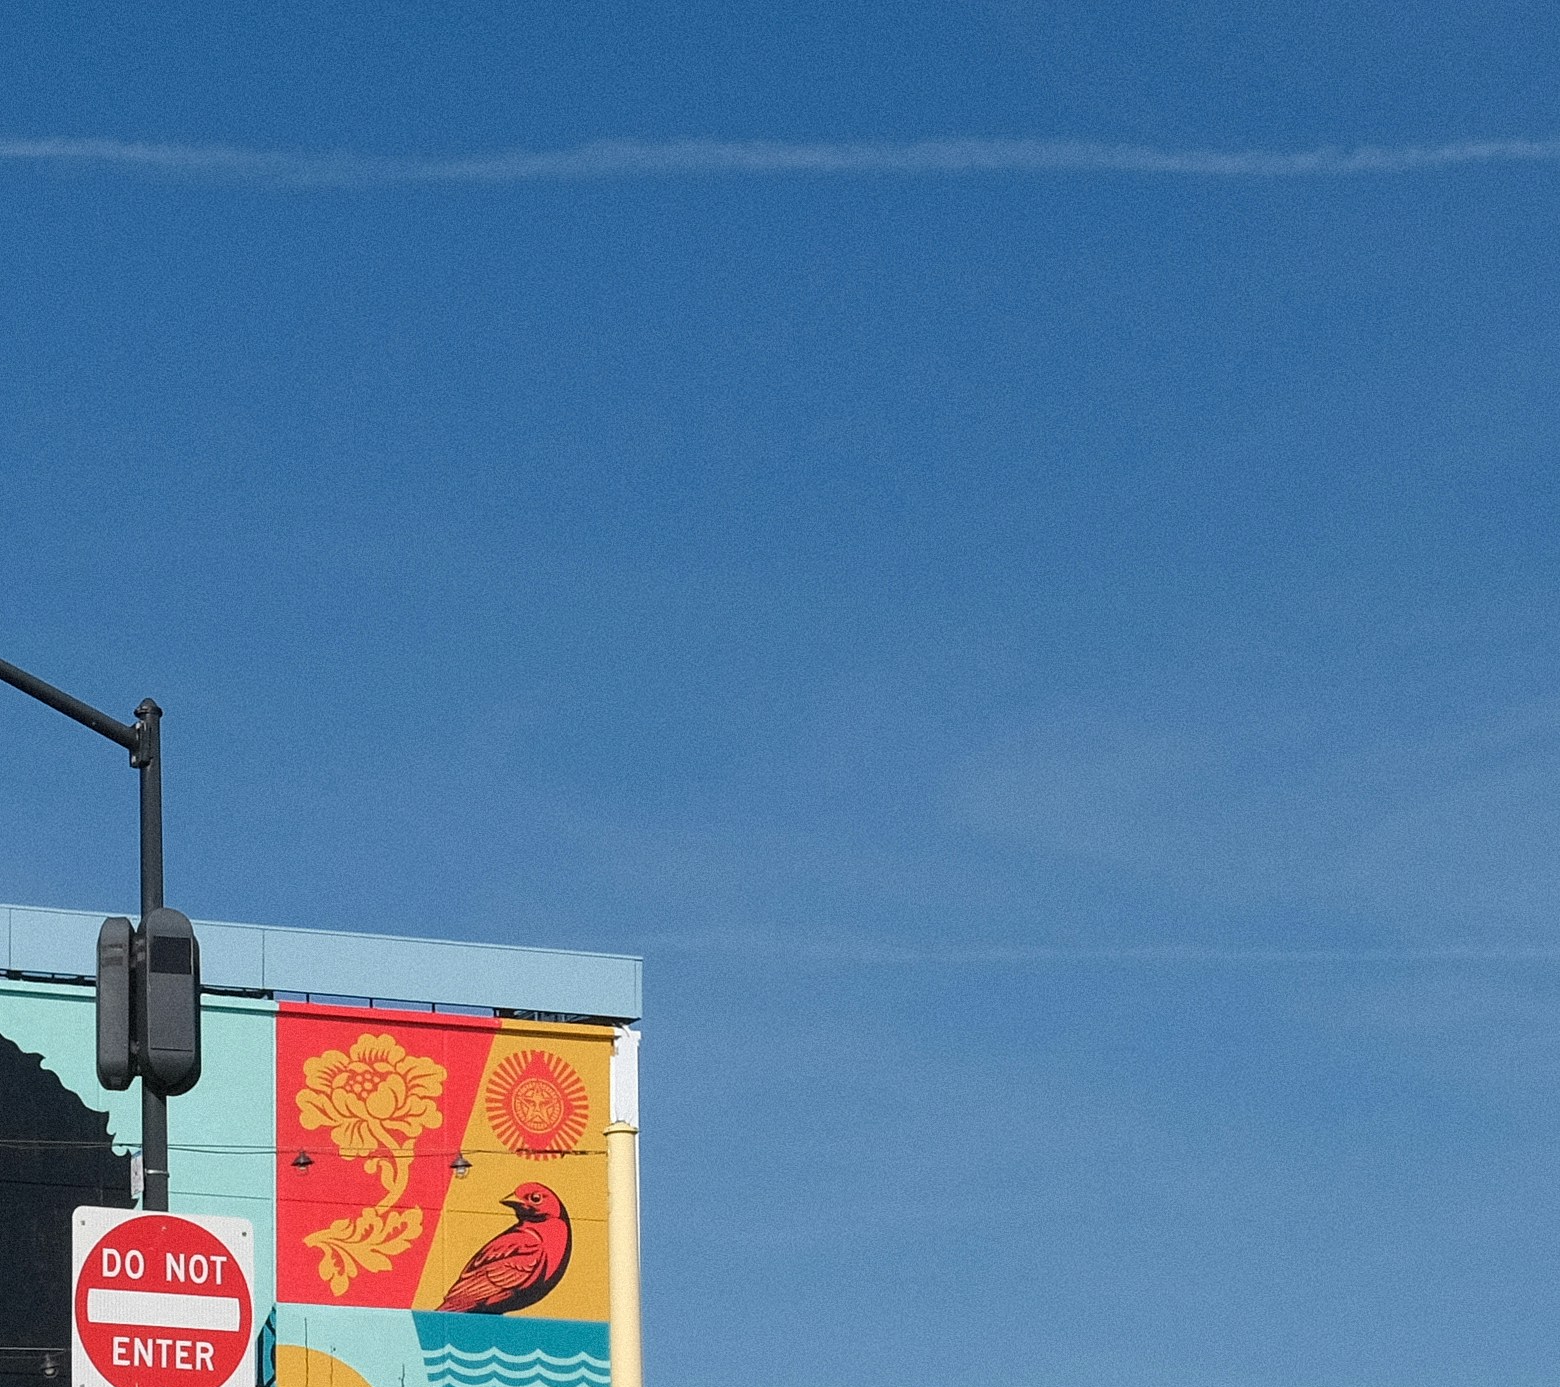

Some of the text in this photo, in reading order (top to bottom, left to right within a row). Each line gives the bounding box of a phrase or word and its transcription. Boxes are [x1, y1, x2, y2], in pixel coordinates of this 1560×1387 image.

[102, 1247, 228, 1285] DO NOT
[111, 1336, 215, 1371] ENTER
